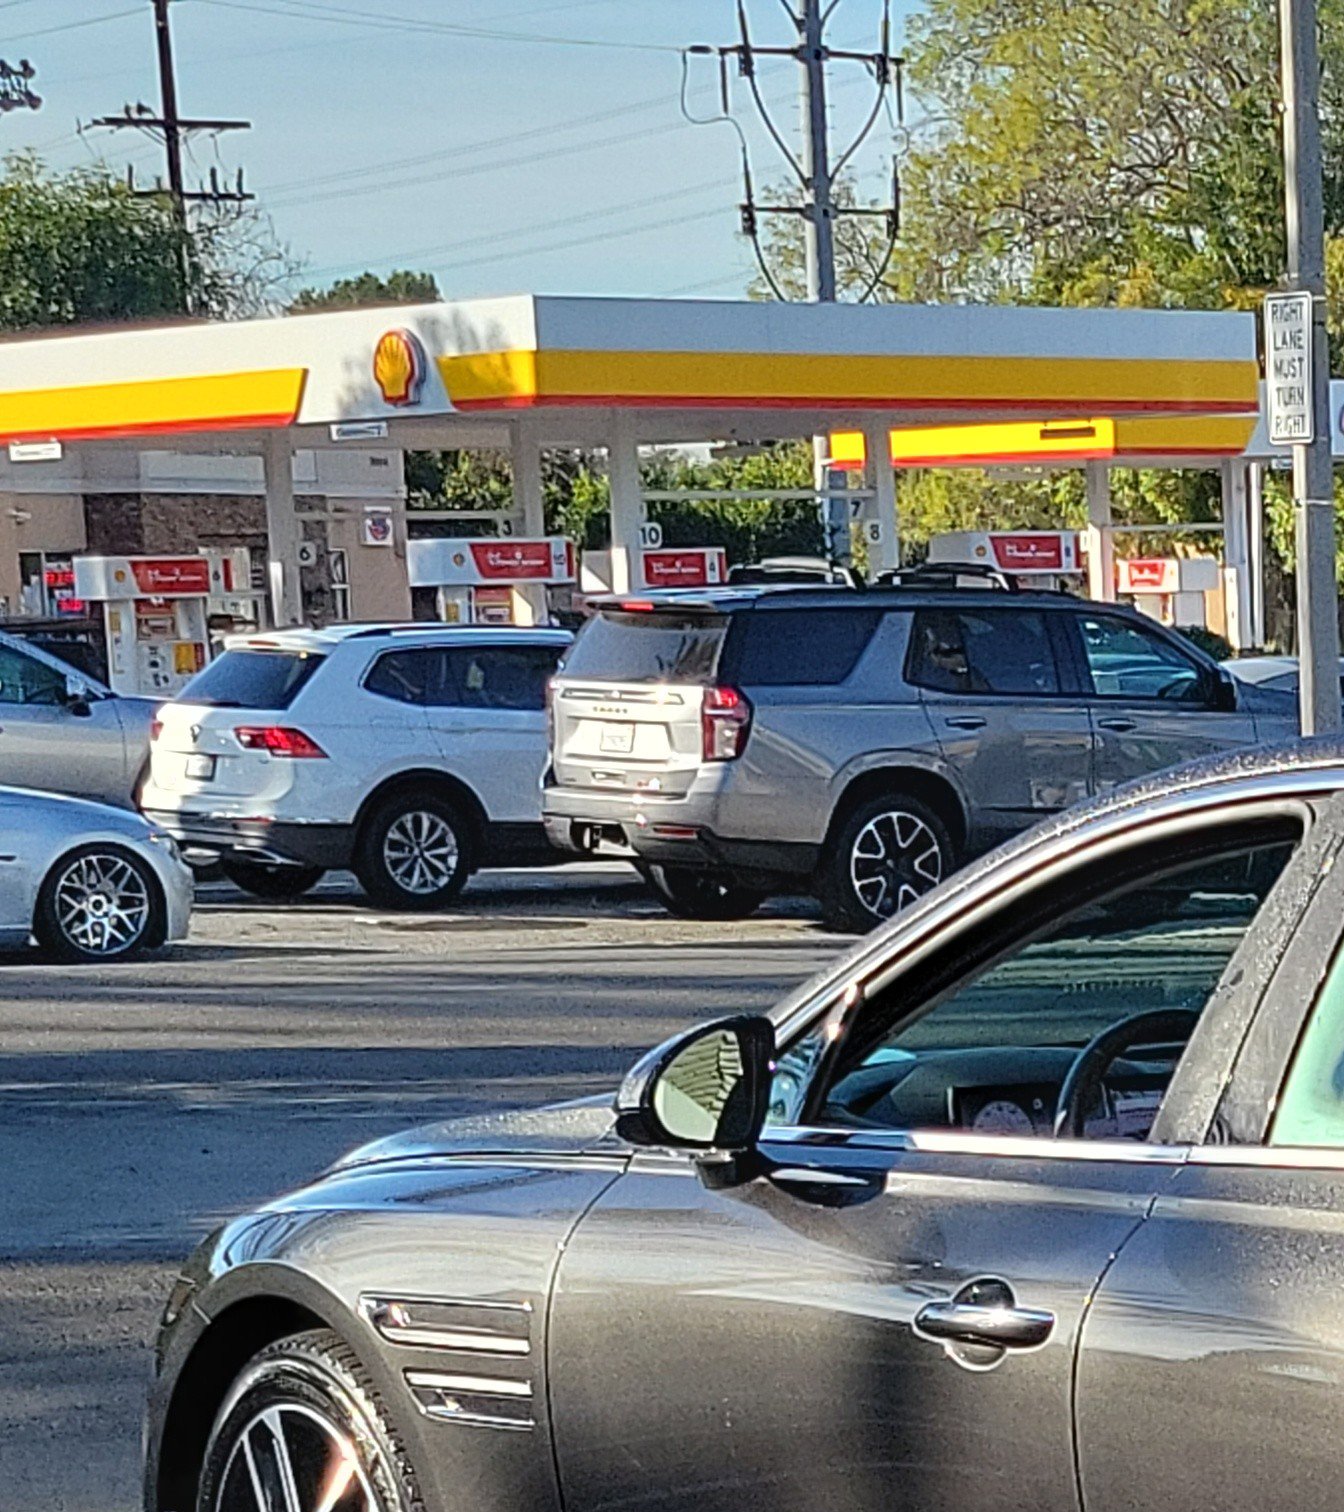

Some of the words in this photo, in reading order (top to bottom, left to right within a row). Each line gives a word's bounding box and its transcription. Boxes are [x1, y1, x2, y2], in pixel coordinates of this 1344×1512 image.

[1271, 303, 1304, 322] RIGHT
[1273, 329, 1304, 351] LANE
[1274, 357, 1304, 379] MUST
[1276, 386, 1304, 407] TURN
[1275, 414, 1306, 435] RIGHT
[851, 501, 860, 517] 7
[640, 526, 660, 544] 10
[300, 546, 310, 561] 6
